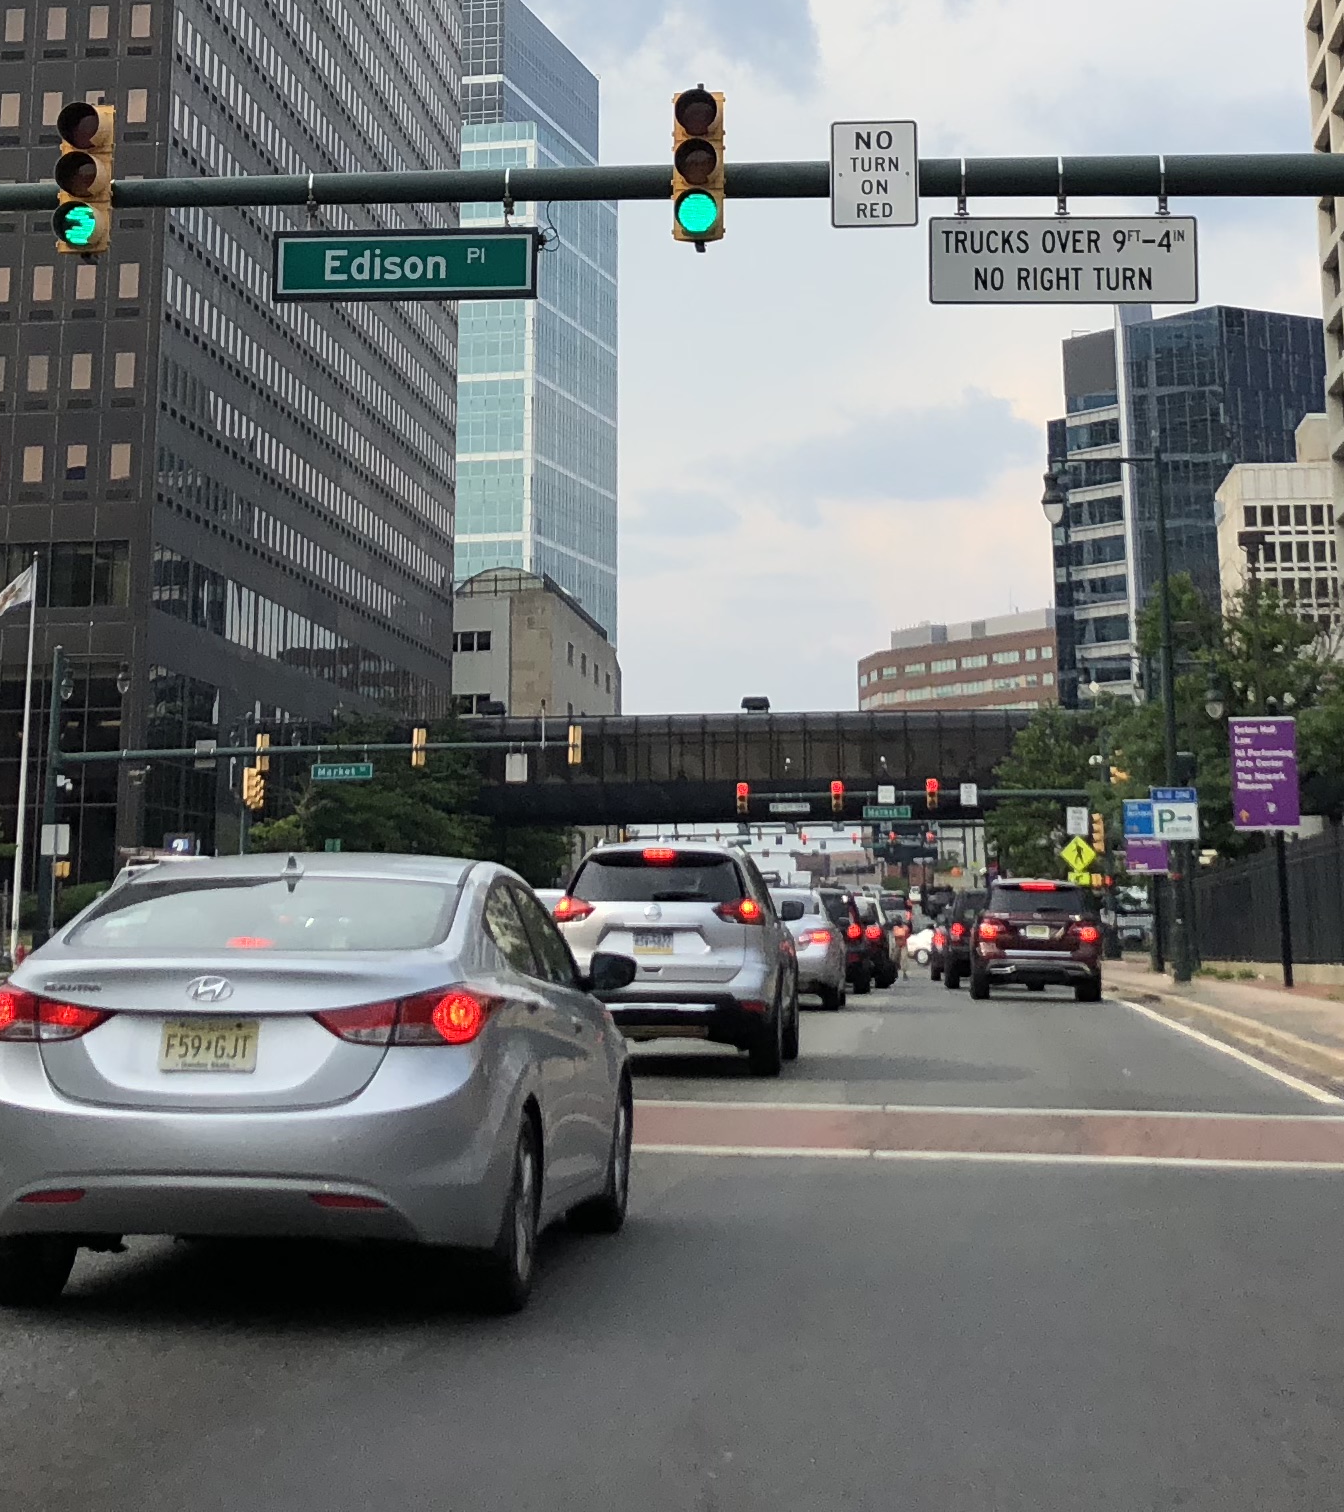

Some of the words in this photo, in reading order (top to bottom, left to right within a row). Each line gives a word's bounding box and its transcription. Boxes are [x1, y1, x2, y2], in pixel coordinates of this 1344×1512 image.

[855, 130, 893, 150] NO
[850, 156, 899, 172] TURN
[861, 179, 888, 195] ON
[856, 202, 893, 219] RED
[941, 230, 1030, 254] TRUCKS
[1041, 230, 1101, 254] OVER
[324, 248, 447, 280] Edison
[467, 247, 485, 264] Pl
[973, 267, 1004, 291] NO
[1017, 267, 1083, 291] RIGHT
[1093, 267, 1152, 291] TURN
[317, 767, 355, 777] Market
[1158, 809, 1175, 833] P
